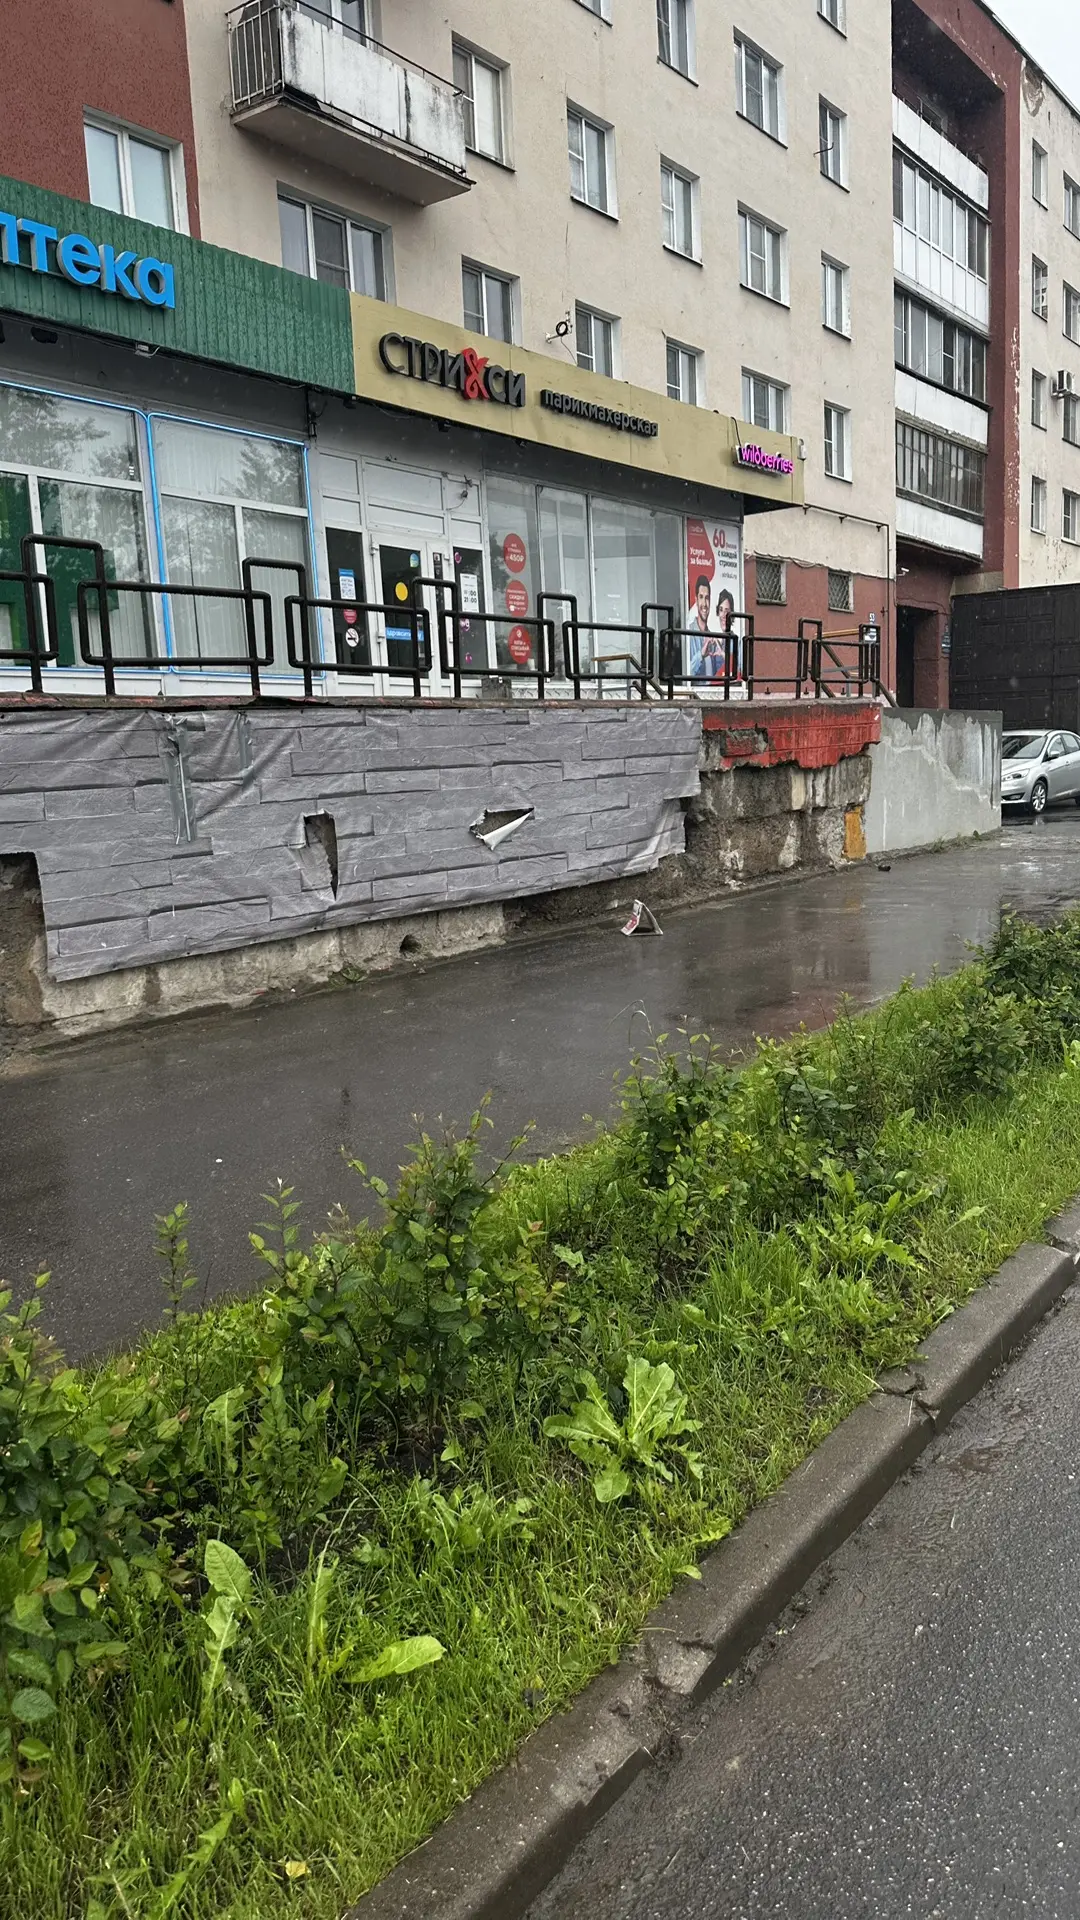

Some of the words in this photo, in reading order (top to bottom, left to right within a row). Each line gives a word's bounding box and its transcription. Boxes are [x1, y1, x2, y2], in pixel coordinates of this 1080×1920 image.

[542, 389, 658, 437] парикмахерская
[741, 444, 794, 473] wildberries
[713, 528, 726, 548] 60
